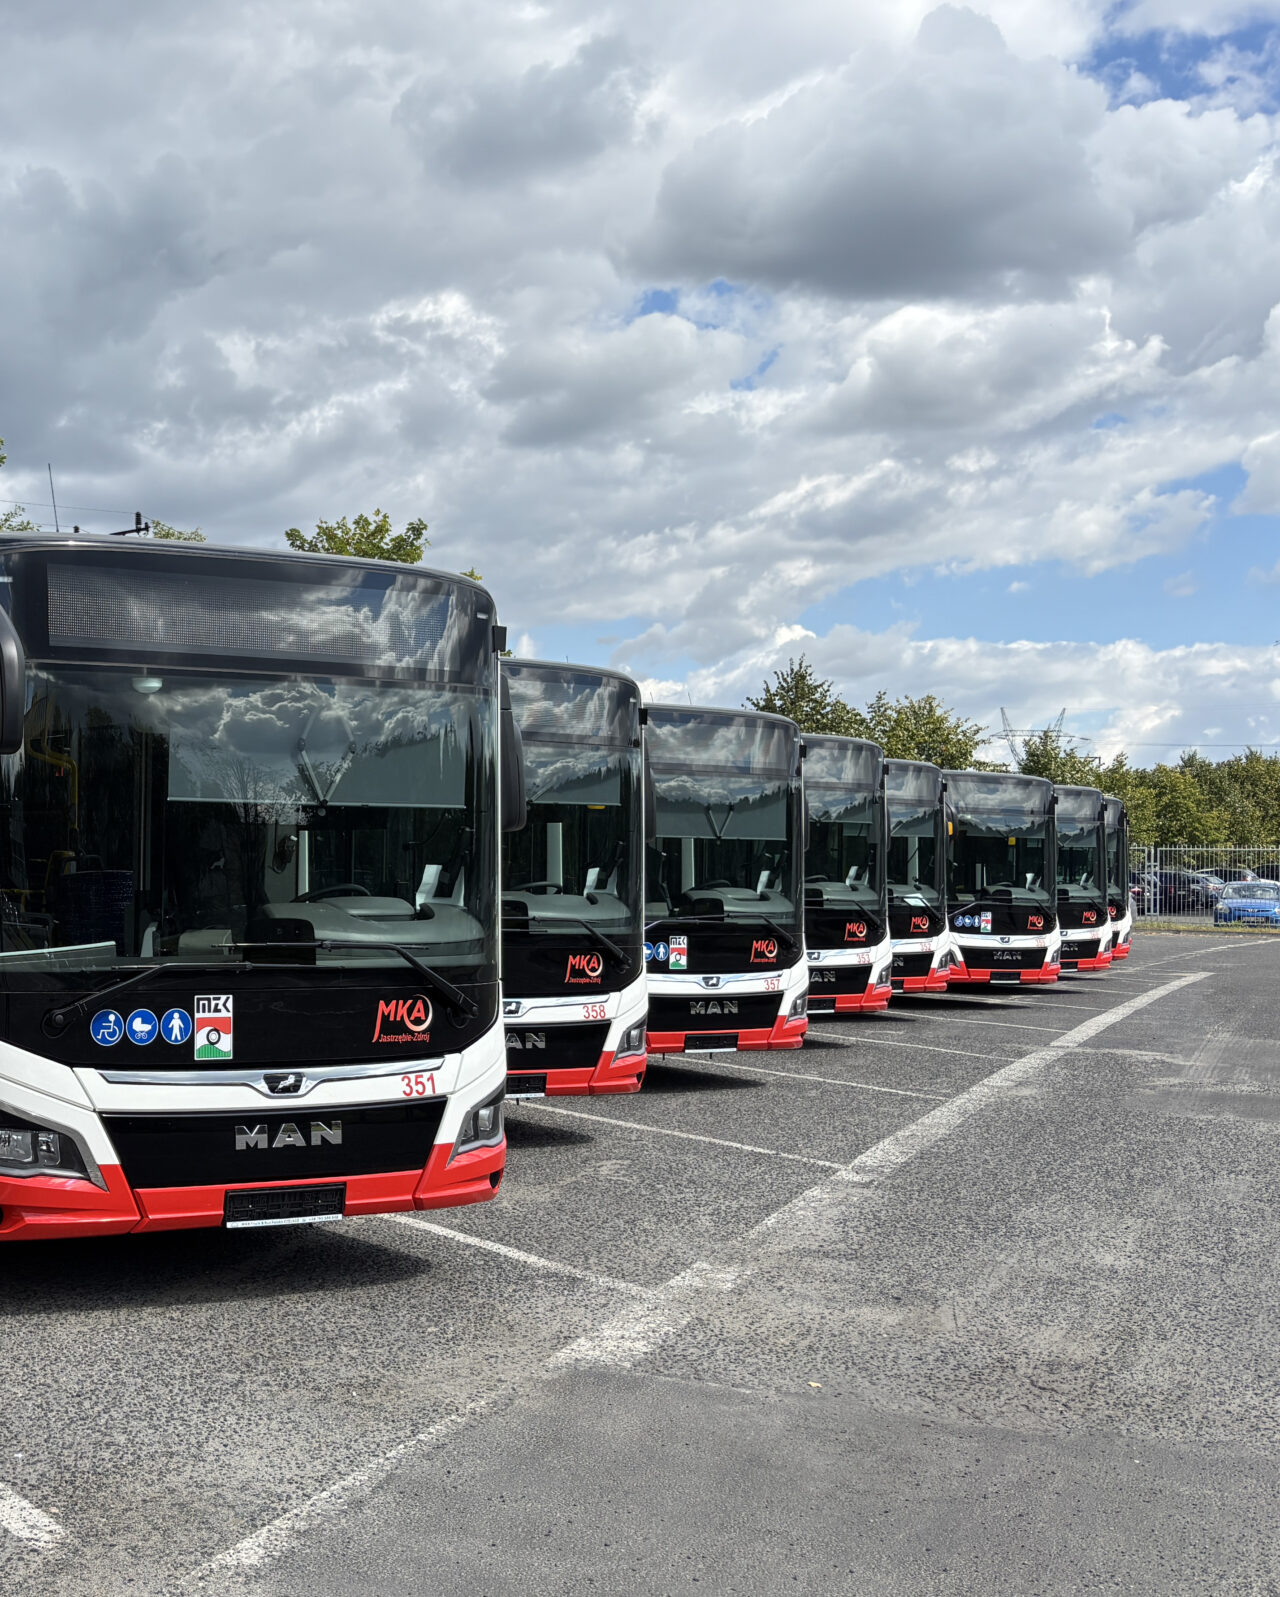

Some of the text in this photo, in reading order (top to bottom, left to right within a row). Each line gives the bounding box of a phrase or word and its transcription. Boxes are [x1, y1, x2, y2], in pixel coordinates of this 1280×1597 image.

[911, 915, 928, 932] MKA
[1027, 914, 1043, 930] MKA
[845, 921, 867, 941] MKA
[750, 938, 777, 963] MKA
[993, 951, 1021, 960] MAN
[565, 952, 603, 983] MKA
[811, 971, 836, 982] AN
[764, 979, 780, 991] 357
[196, 997, 231, 1013] MZK
[583, 1004, 606, 1019] 358
[690, 1001, 738, 1015] MAN
[372, 994, 432, 1042] MKA
[506, 1033, 545, 1049] AN
[401, 1073, 436, 1097] 351
[235, 1120, 342, 1150] MAN
